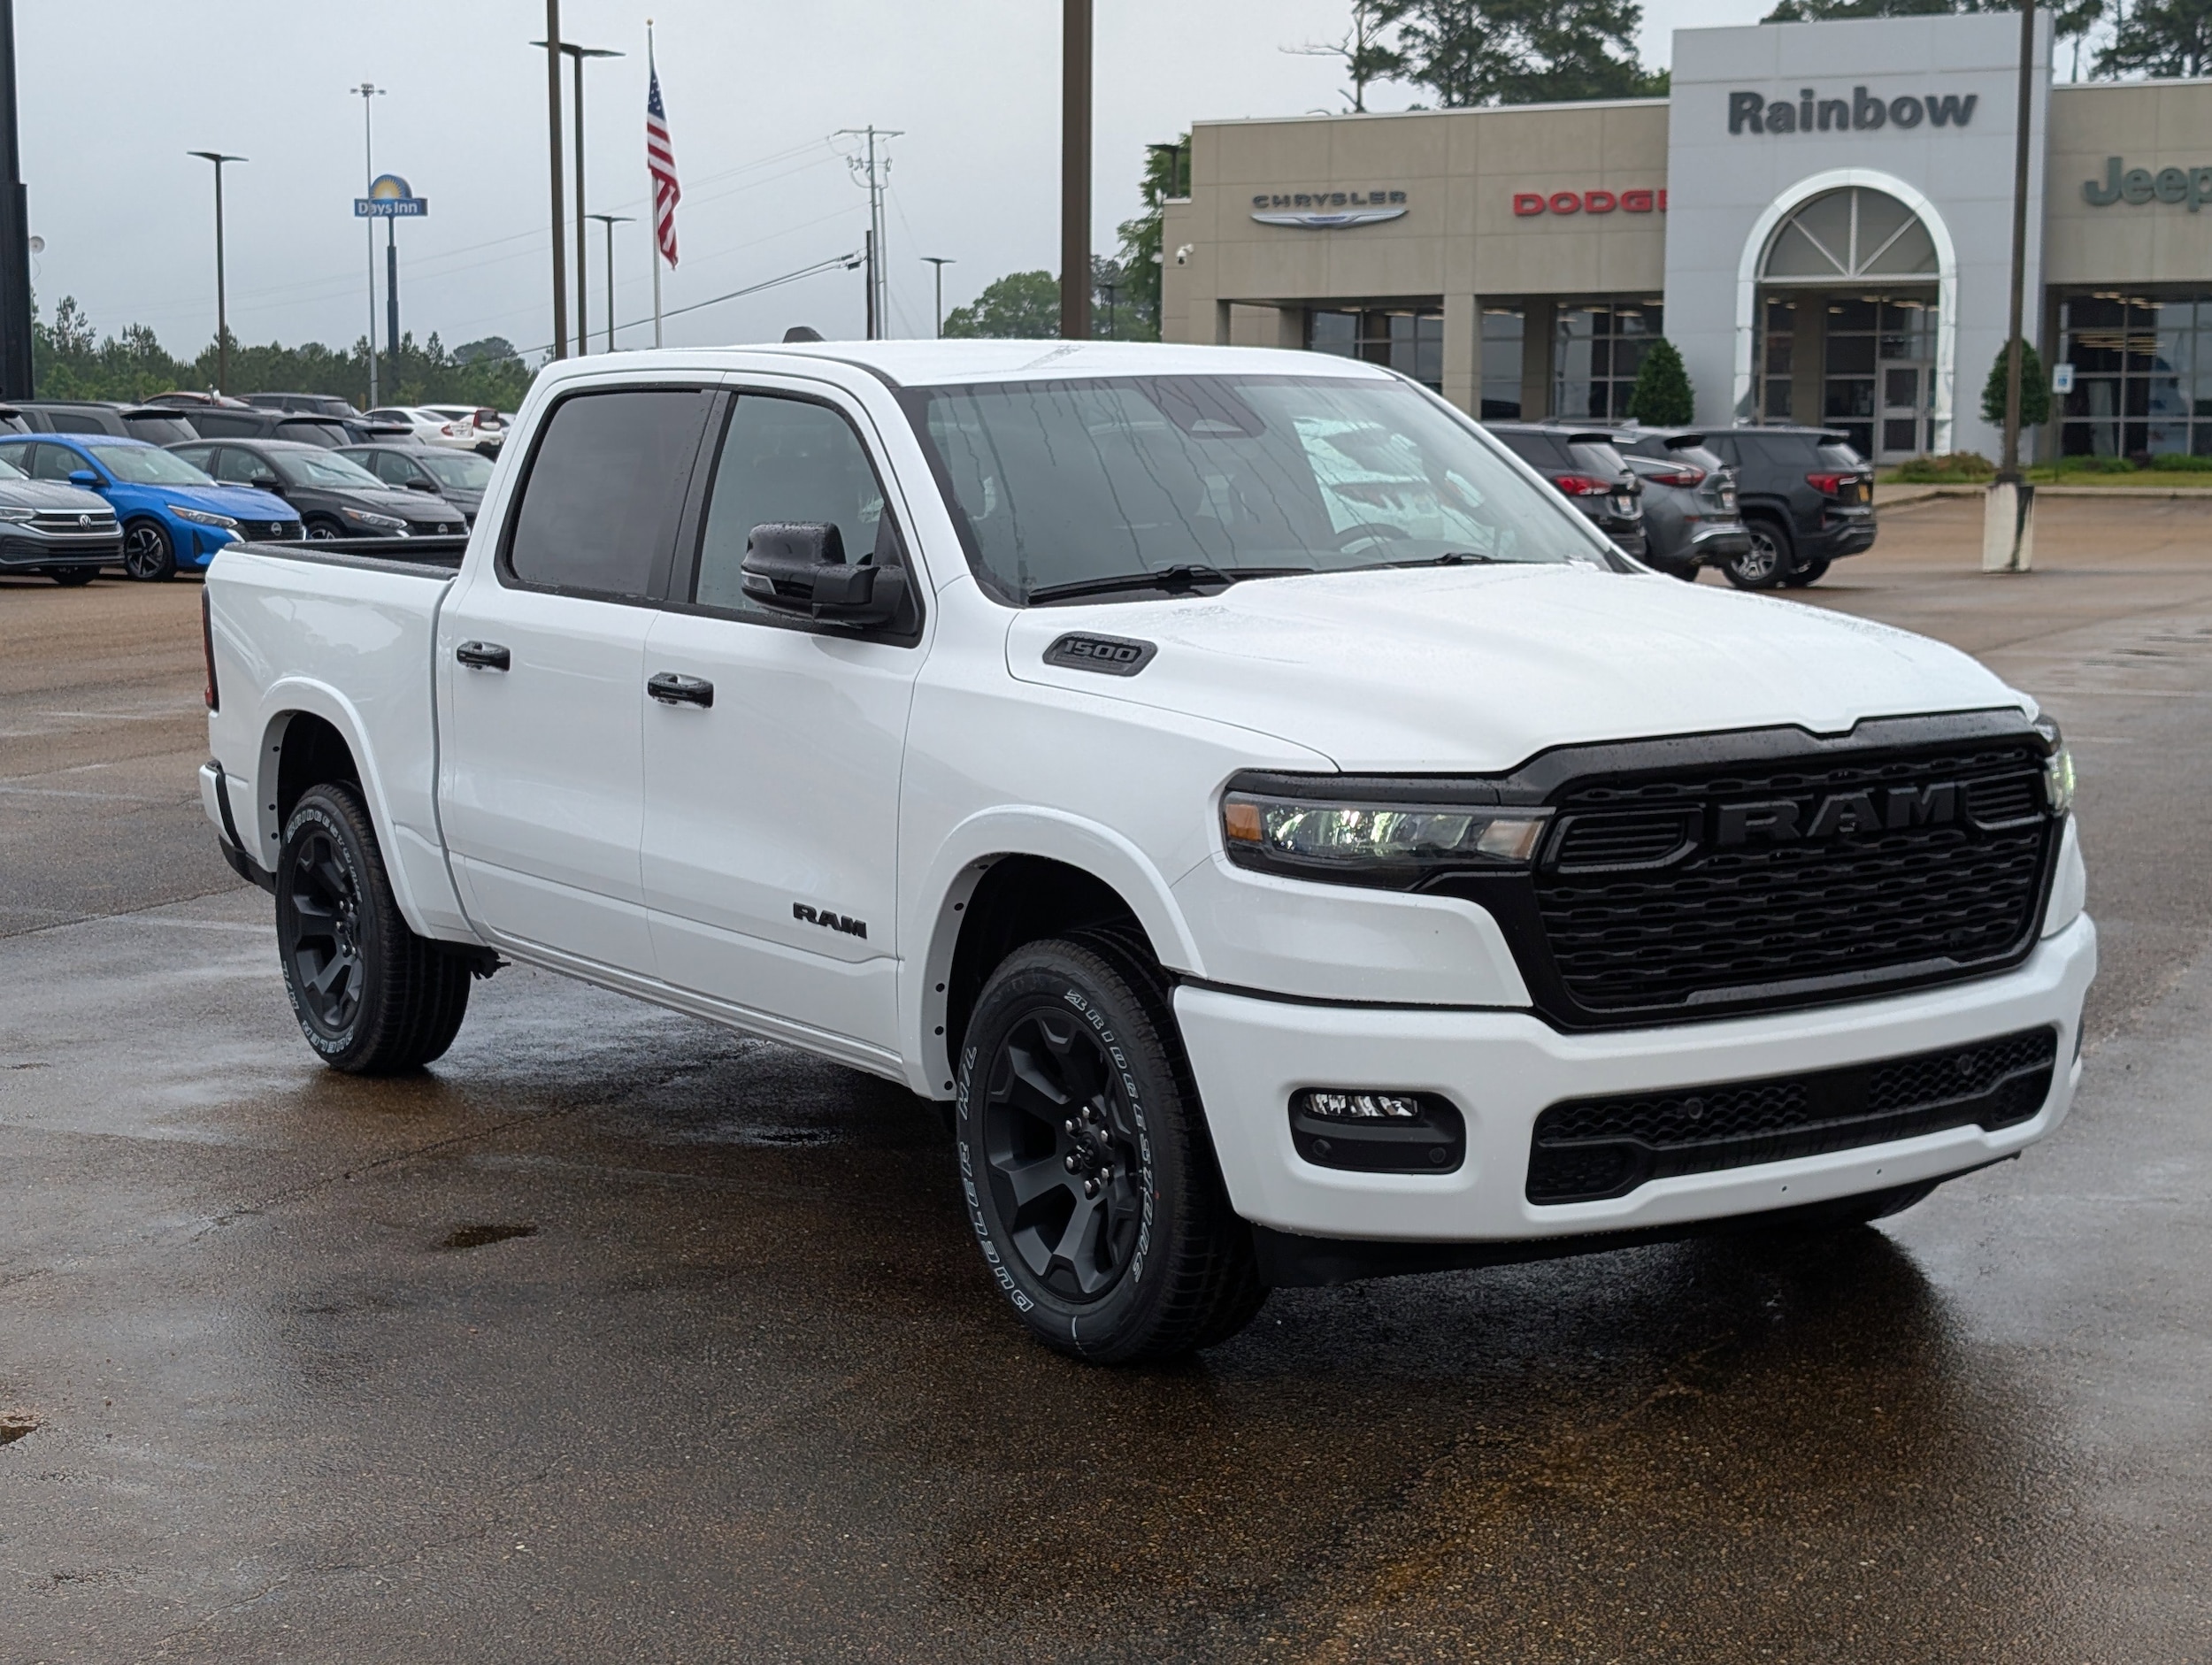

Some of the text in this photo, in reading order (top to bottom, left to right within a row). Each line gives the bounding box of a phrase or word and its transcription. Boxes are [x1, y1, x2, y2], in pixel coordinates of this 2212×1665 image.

[1727, 87, 1978, 135] Rainbow
[394, 201, 418, 213] Inn
[1252, 191, 1408, 209] CHRYSLER
[2084, 156, 2212, 213] Jeep
[1064, 640, 1139, 662] 1500
[1719, 780, 1955, 842] RAM
[793, 902, 867, 940] RAM
[1064, 988, 1153, 1283] BRIDGESTONE
[959, 1141, 1034, 1313] DUELER
